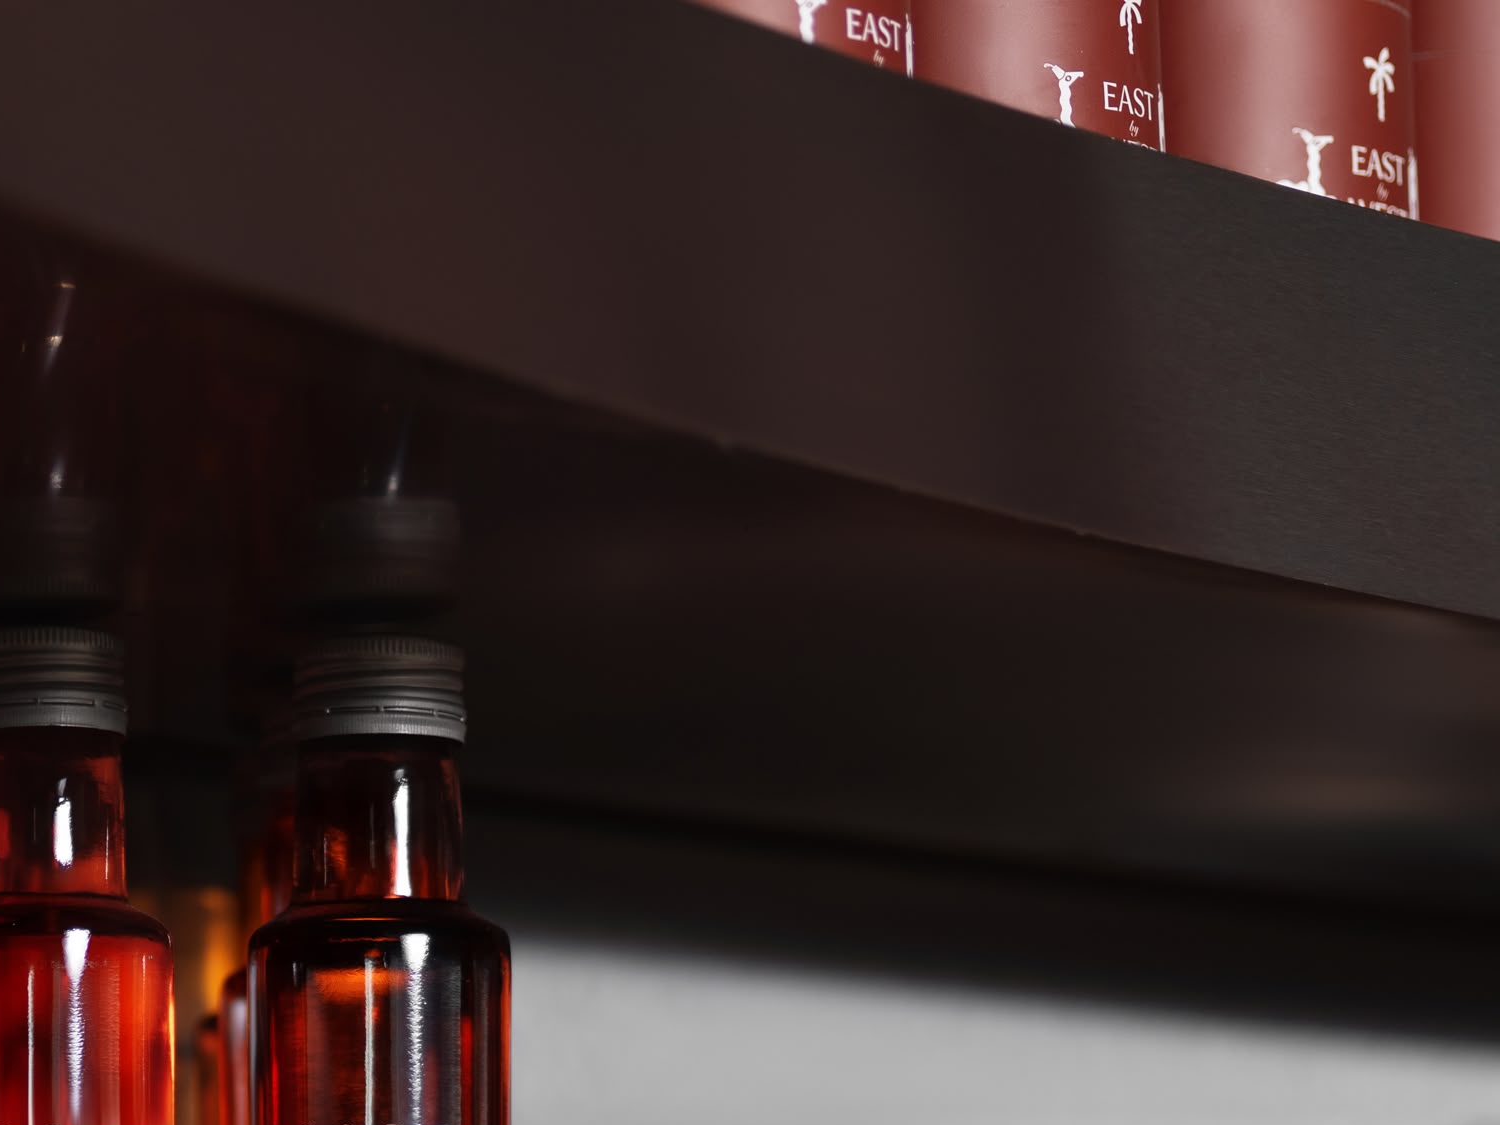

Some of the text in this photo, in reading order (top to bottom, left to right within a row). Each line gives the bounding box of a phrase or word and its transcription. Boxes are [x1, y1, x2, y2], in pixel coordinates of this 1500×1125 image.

[846, 7, 902, 52] EAST
[1103, 81, 1154, 121] EAST
[1129, 120, 1140, 137] by
[1351, 145, 1405, 187] EAST
